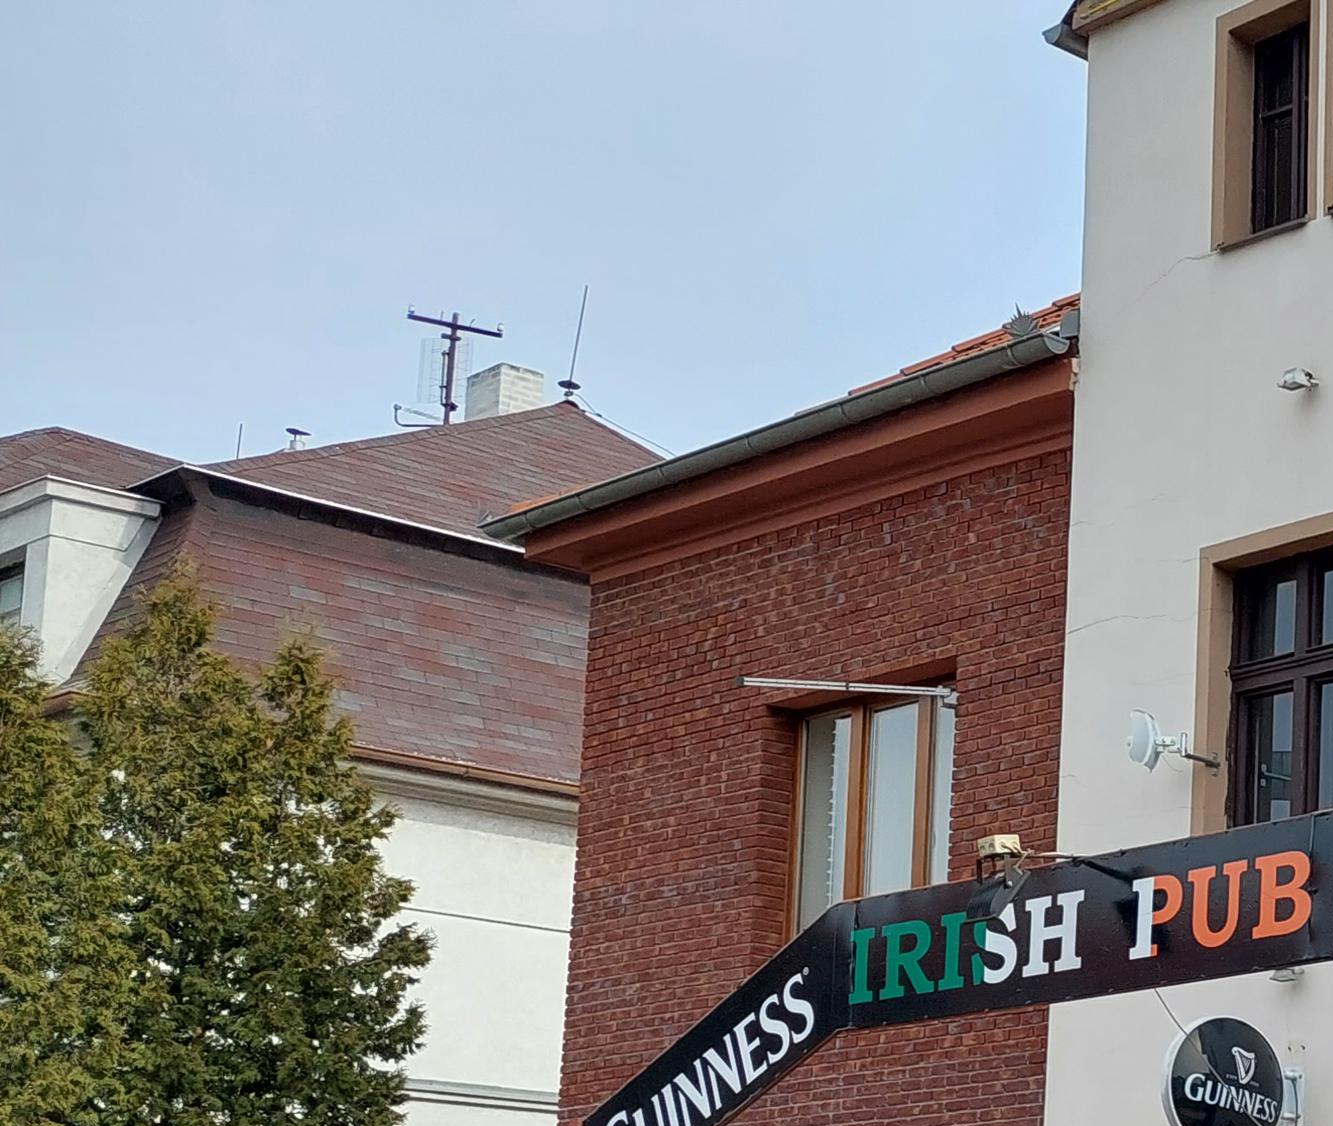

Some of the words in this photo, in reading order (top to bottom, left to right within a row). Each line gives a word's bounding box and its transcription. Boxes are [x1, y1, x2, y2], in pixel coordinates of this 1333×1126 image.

[849, 889, 1085, 1005] IRISH
[1129, 850, 1312, 961] PUB
[1184, 1073, 1278, 1123] GUINNESS
